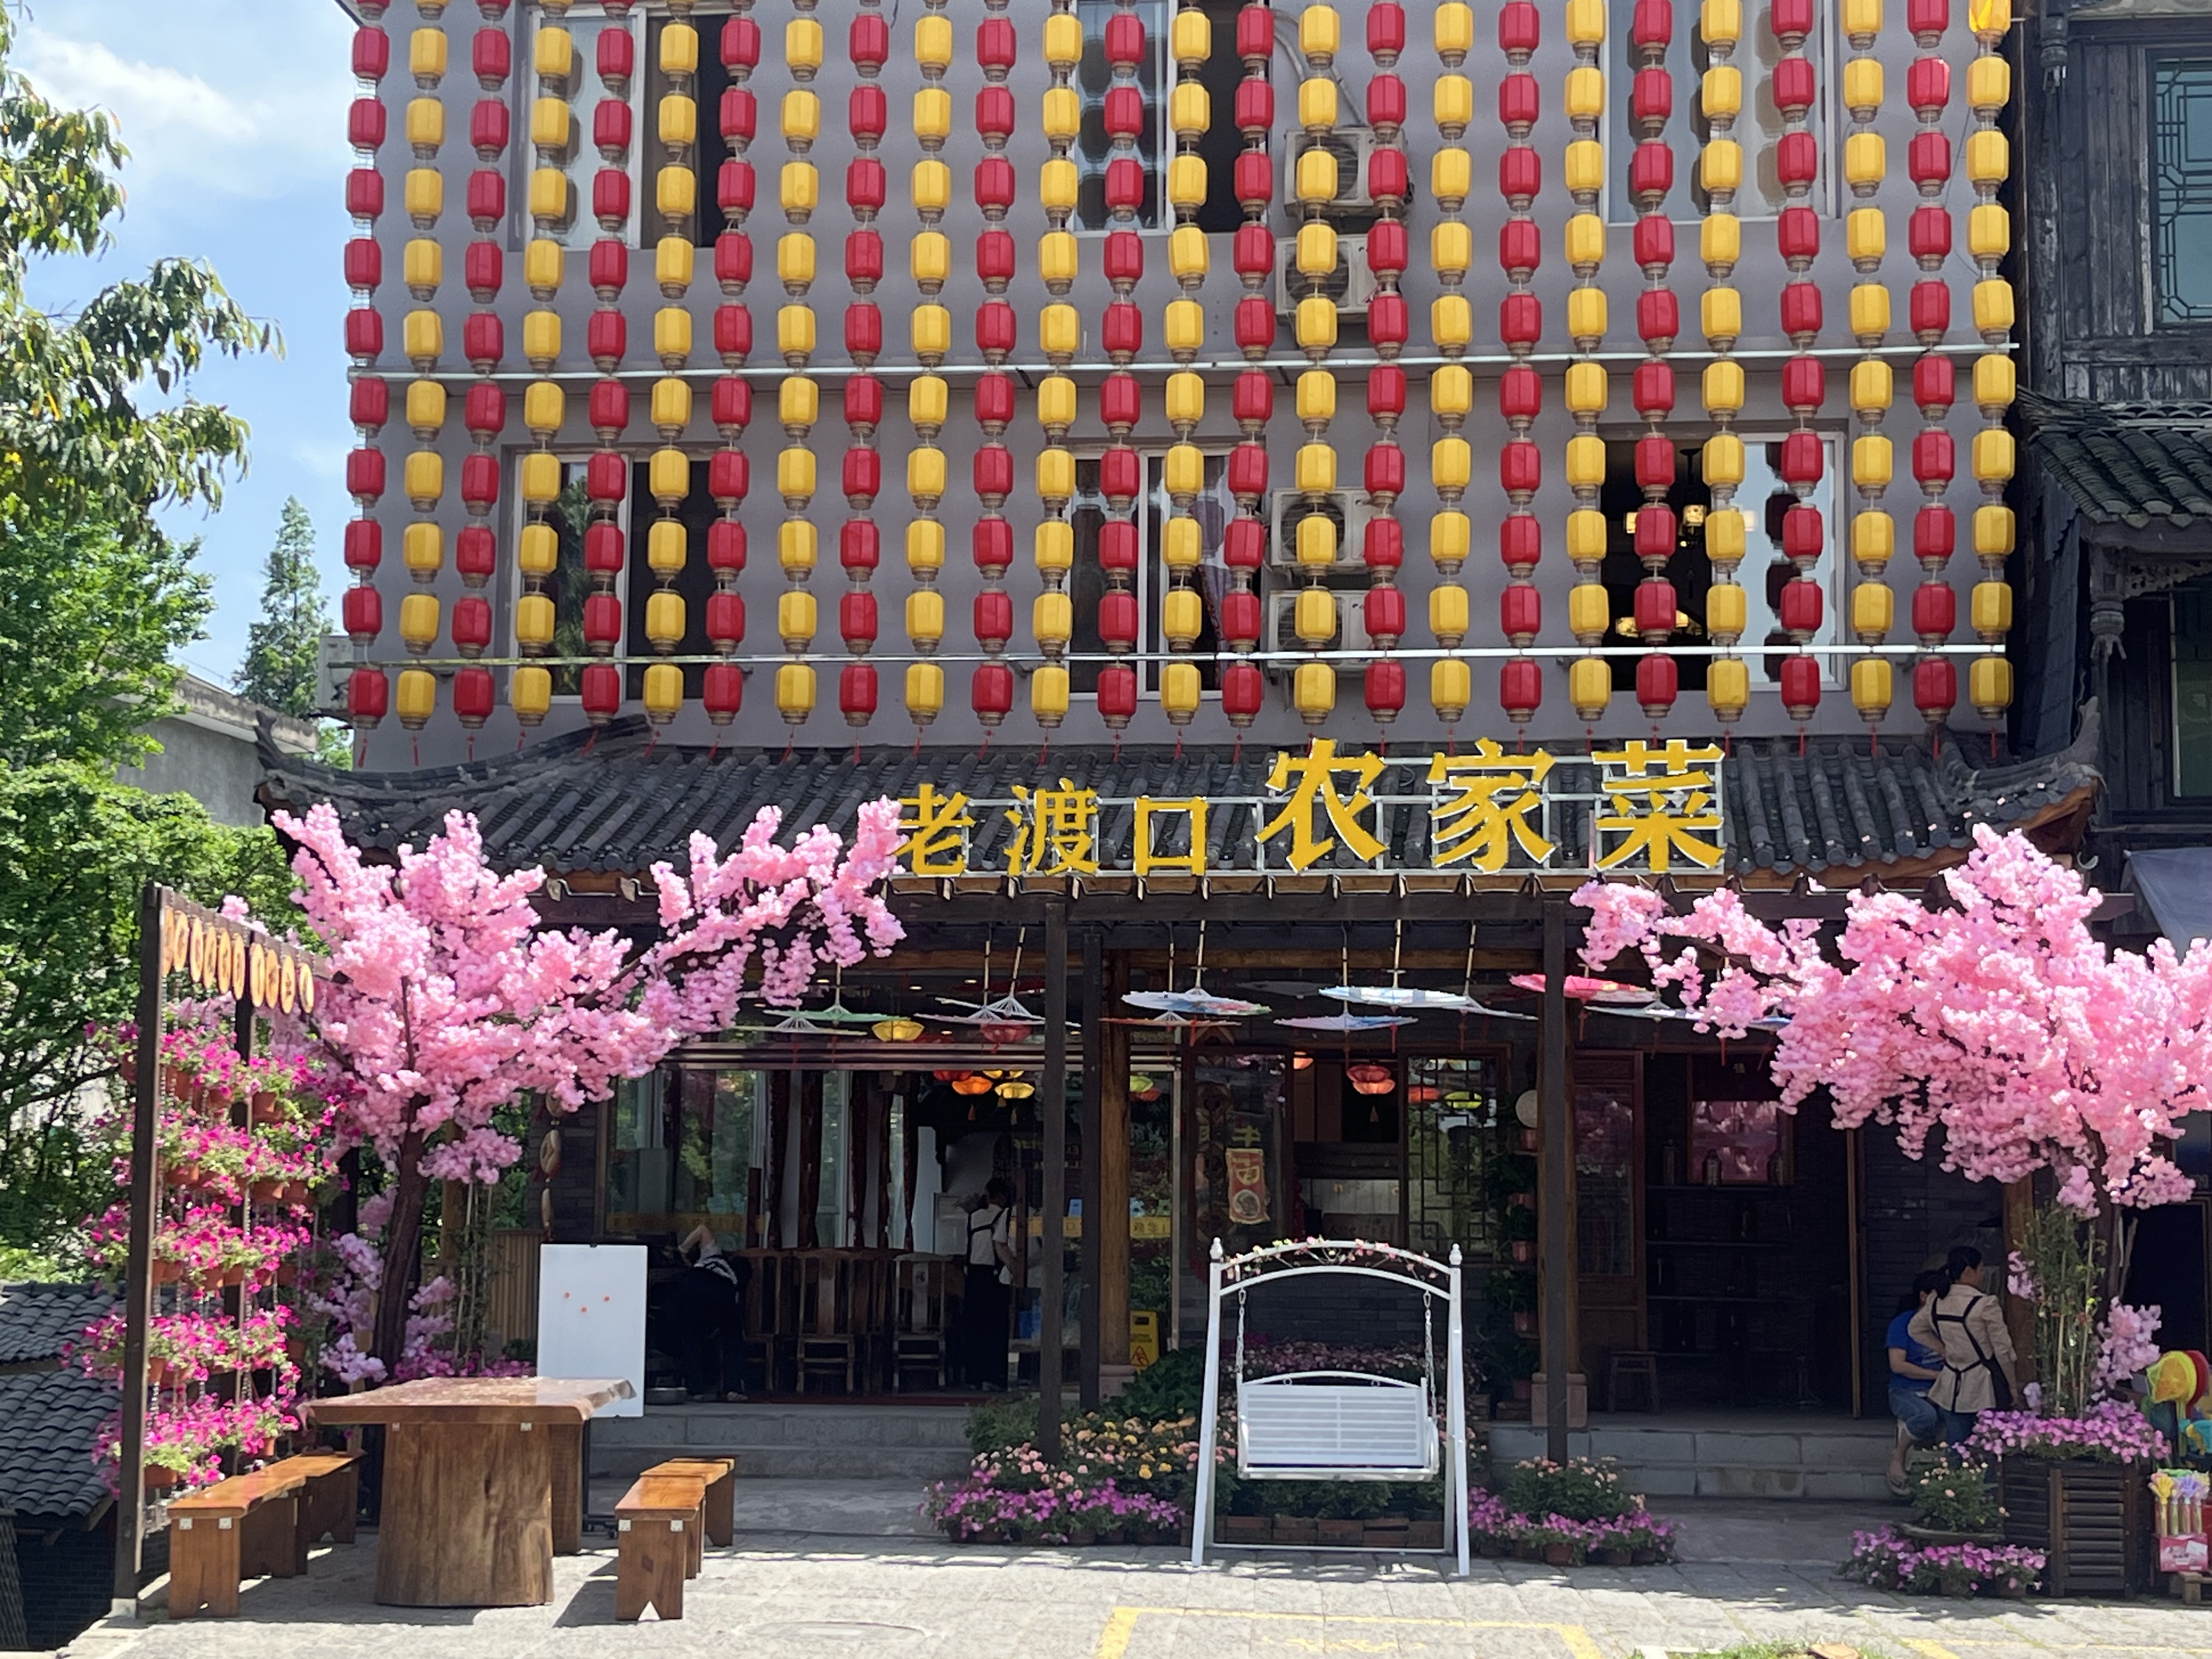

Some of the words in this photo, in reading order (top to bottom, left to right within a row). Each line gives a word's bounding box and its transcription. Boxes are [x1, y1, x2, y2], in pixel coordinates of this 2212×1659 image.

[889, 738, 1725, 877] 老渡口农家菜
